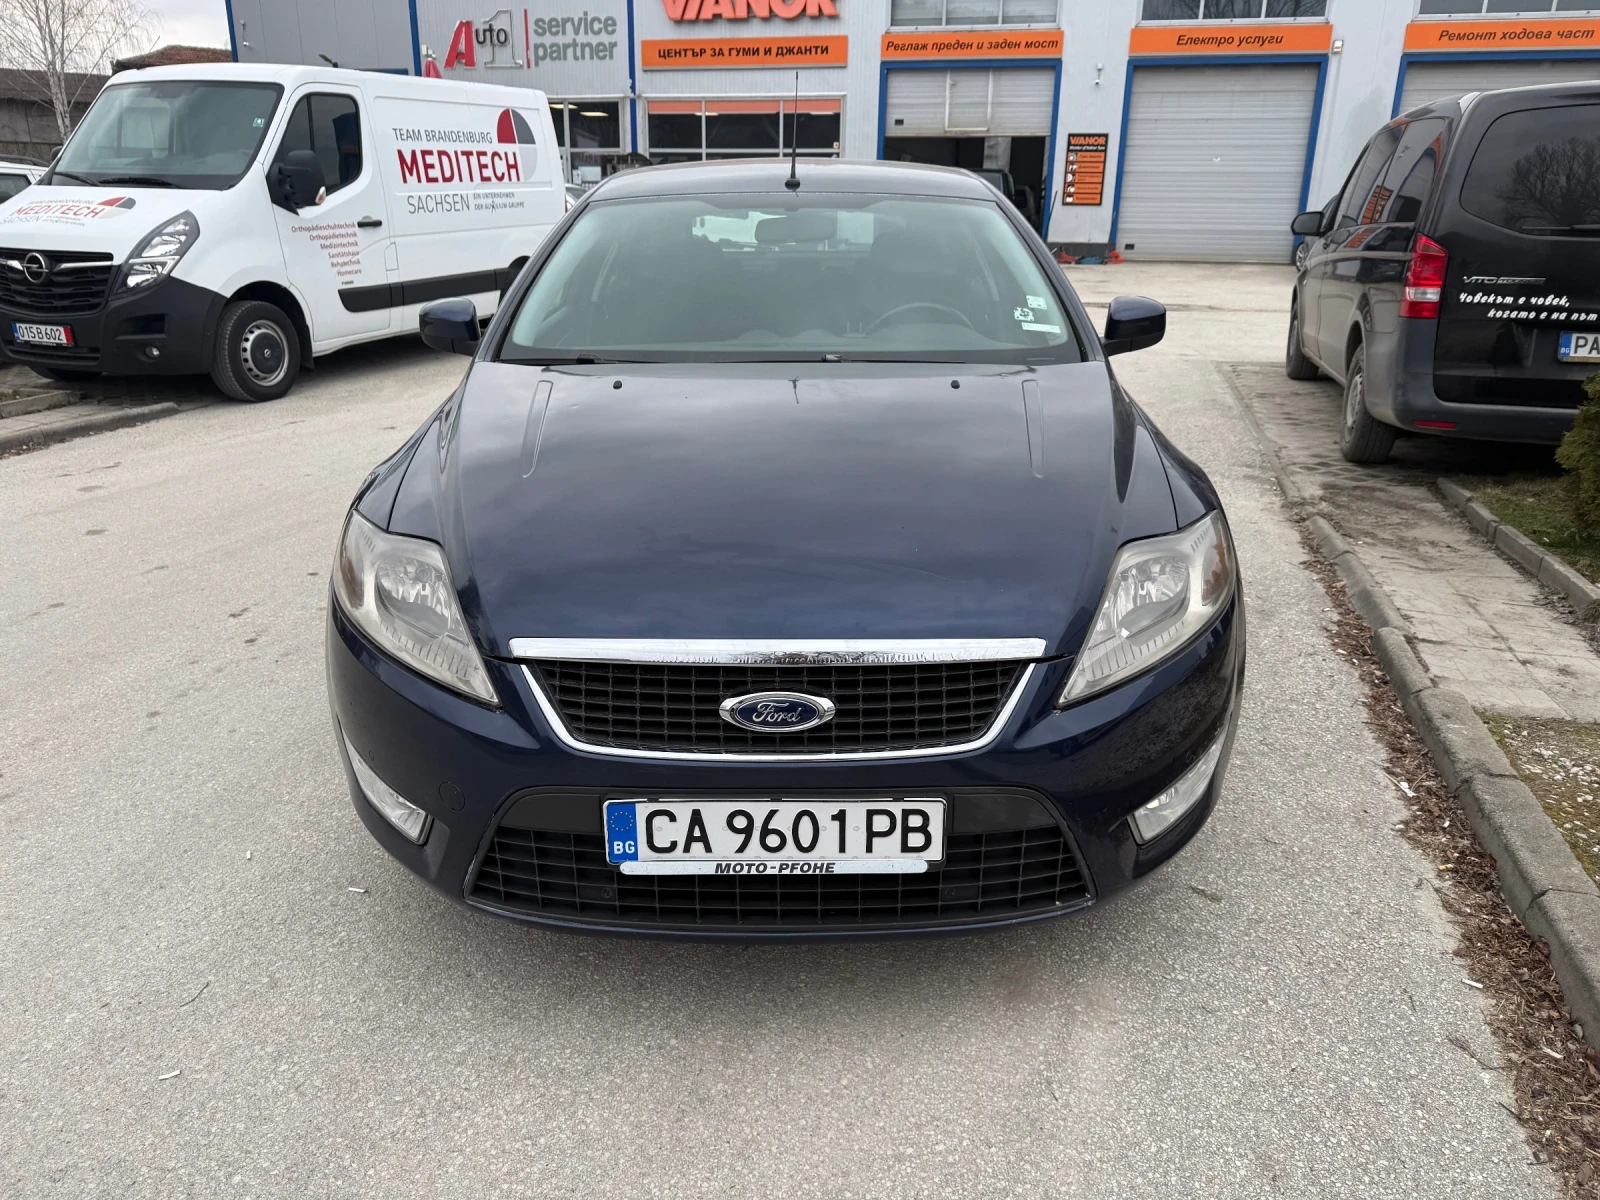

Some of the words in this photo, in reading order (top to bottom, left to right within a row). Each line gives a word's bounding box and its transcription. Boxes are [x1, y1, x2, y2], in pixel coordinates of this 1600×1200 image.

[533, 11, 617, 37] service
[1176, 34, 1235, 47] Електро
[1237, 34, 1284, 48] услуги
[1438, 29, 1496, 41] Ремонт
[1500, 28, 1552, 40] ходова
[1557, 28, 1595, 39] част
[658, 48, 706, 59] ЦЕНТЪР
[710, 48, 724, 58] ЗА
[728, 47, 760, 58] ГУМИ
[763, 46, 772, 56] И
[775, 45, 829, 58] ДЖАНТИ
[886, 40, 928, 51] Реглаж
[931, 40, 973, 52] преден
[976, 41, 984, 50] и
[987, 38, 1021, 50] заден
[1024, 38, 1059, 49] мост
[533, 38, 618, 67] partner
[392, 128, 423, 142] TEAM
[424, 129, 493, 144] BRANDENBURG
[1069, 136, 1106, 145] VIANOR
[396, 148, 521, 184] MEDITECH
[9, 204, 105, 218] MEDITECH
[407, 194, 470, 214] SACHSEN
[474, 203, 484, 211] DER
[291, 222, 356, 233] Orthopädieschuhtechnik
[309, 231, 357, 242] Orthopädietechnik
[320, 240, 358, 250] Medizintechnik
[331, 259, 361, 268] Rehatechnik
[337, 268, 362, 277] Homecare
[1463, 276, 1498, 284] VITO
[1459, 292, 1514, 305] Човекът
[1518, 296, 1526, 305] е
[1530, 294, 1571, 307] човек,
[1487, 308, 1537, 320] когато
[1540, 311, 1548, 320] е
[1551, 312, 1567, 320] на
[1571, 312, 1598, 321] път
[752, 702, 802, 722] Ford
[613, 841, 635, 855] BG
[645, 808, 713, 854] CA
[725, 808, 847, 854] 9601
[865, 808, 932, 854] PB
[714, 862, 836, 874] MOTO-PFOHE
